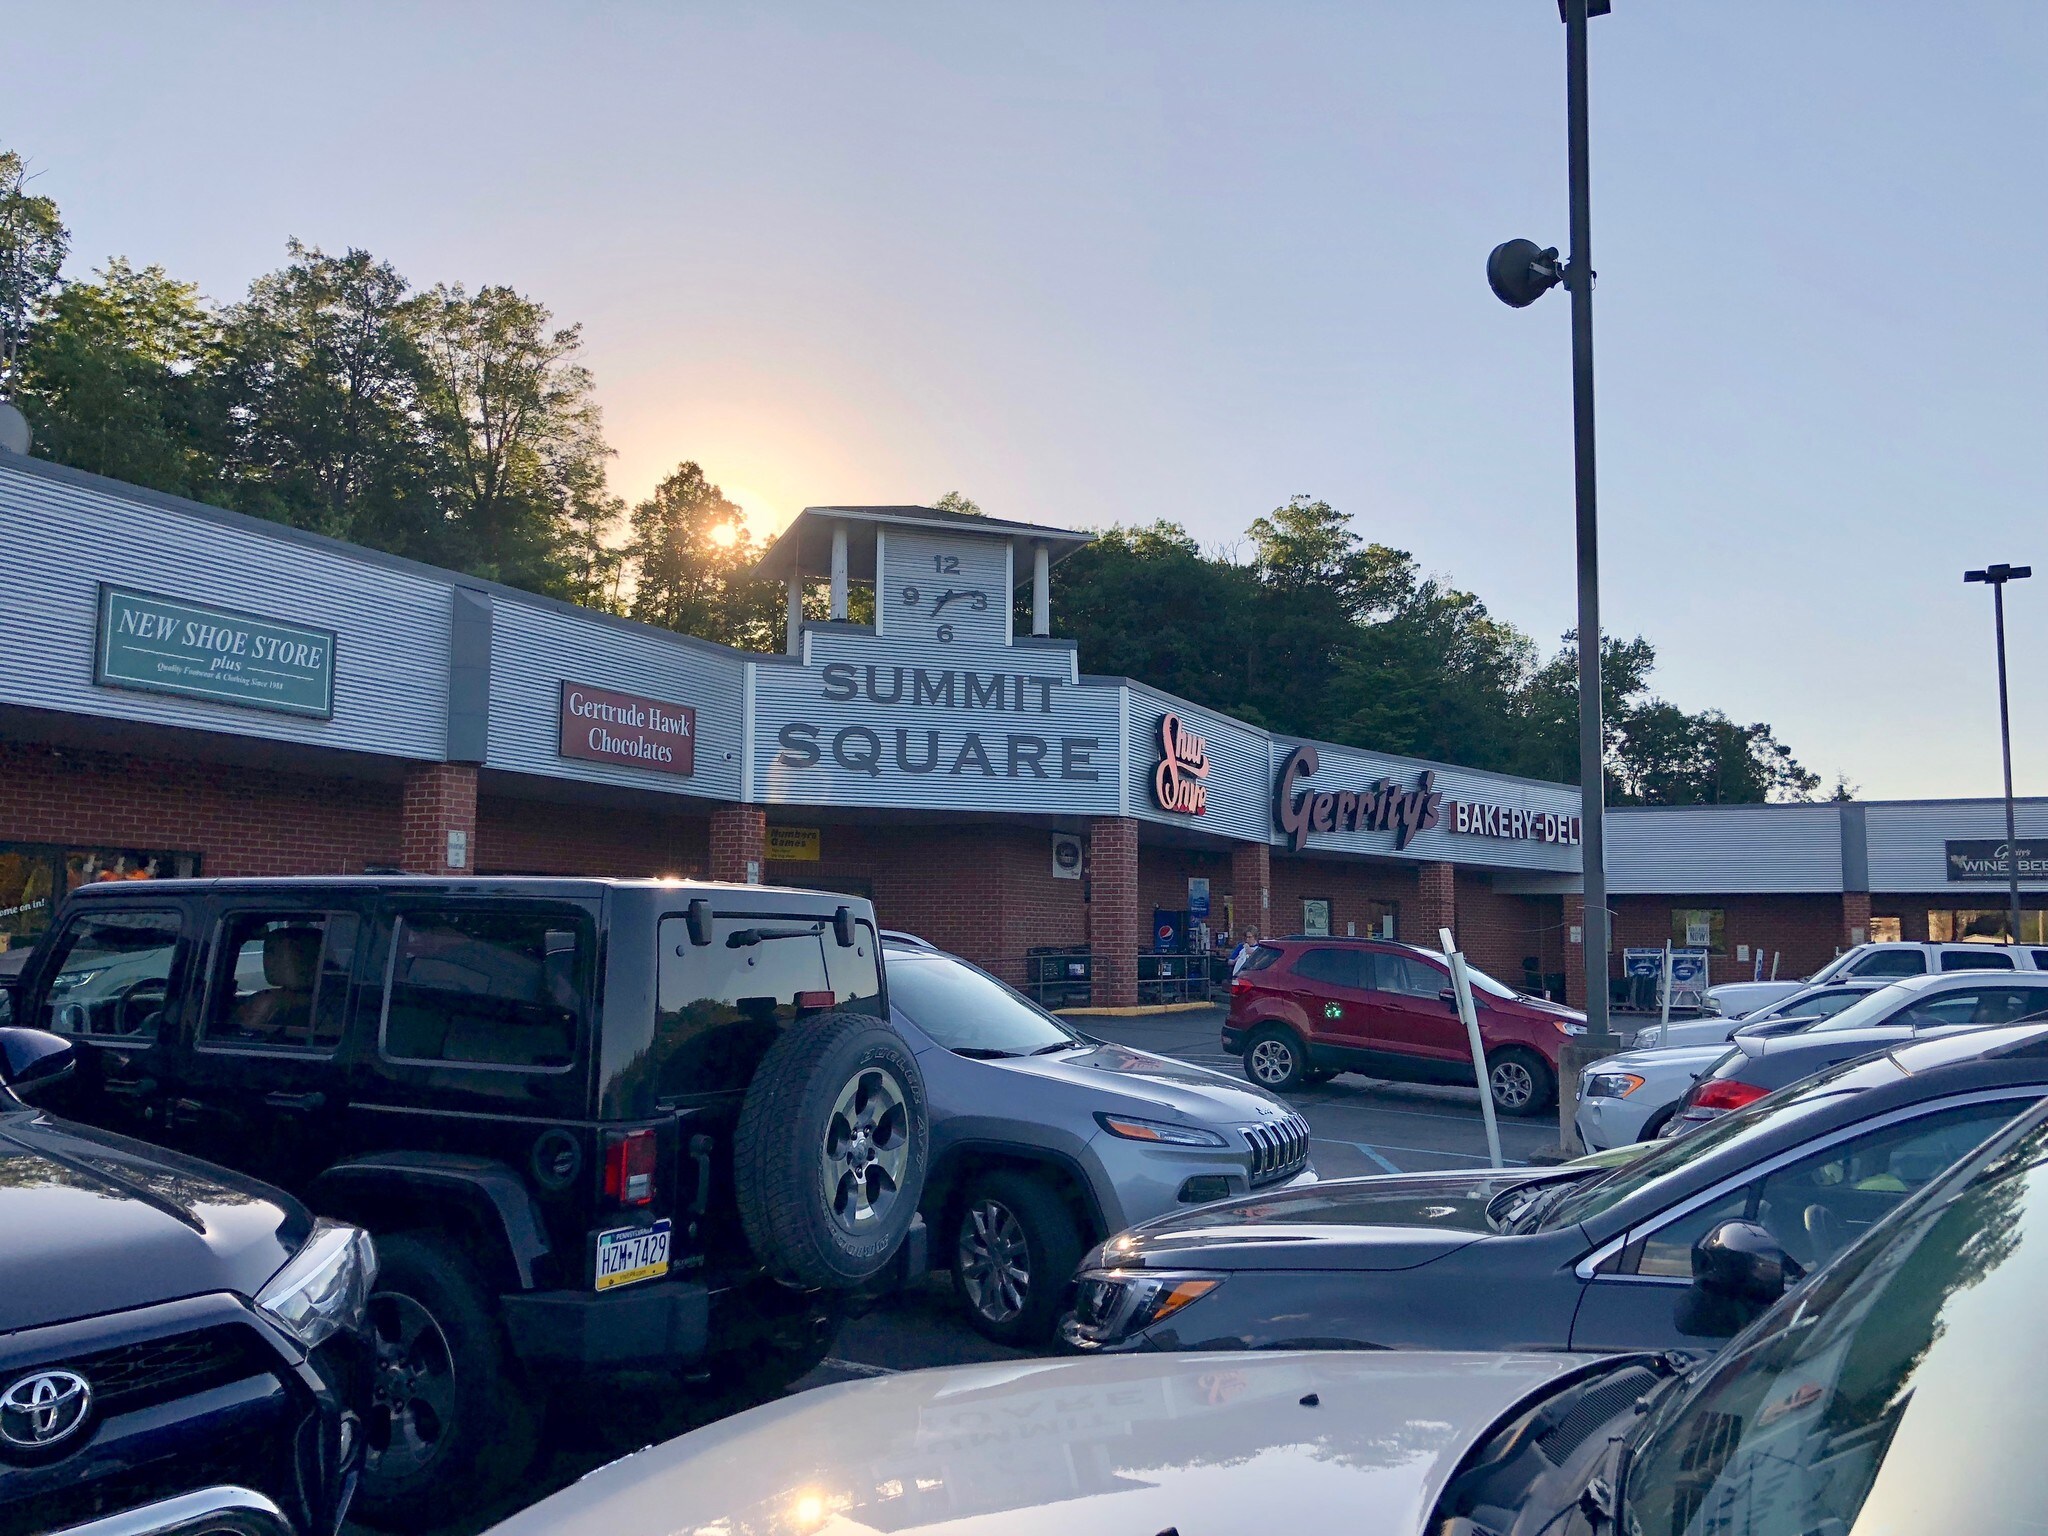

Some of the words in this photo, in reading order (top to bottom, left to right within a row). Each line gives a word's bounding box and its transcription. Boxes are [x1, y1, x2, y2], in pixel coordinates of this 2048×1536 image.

[933, 555, 960, 576] 12
[903, 587, 920, 606] 9
[970, 590, 988, 611] 3
[117, 608, 180, 642] NEW
[182, 621, 249, 656] SHOE
[251, 635, 323, 669] STORE
[937, 624, 954, 643] 6
[157, 662, 182, 676] Quality
[223, 673, 249, 686] Clothing
[210, 655, 242, 672] plus
[820, 663, 1063, 713] SUMMIT
[569, 692, 645, 728] Gertrude
[648, 707, 690, 737] Hawk
[588, 727, 673, 763] Chocolates
[777, 722, 1099, 782] SQUARE
[1273, 745, 1443, 852] Gerrity's
[1963, 860, 2009, 872] WINE
